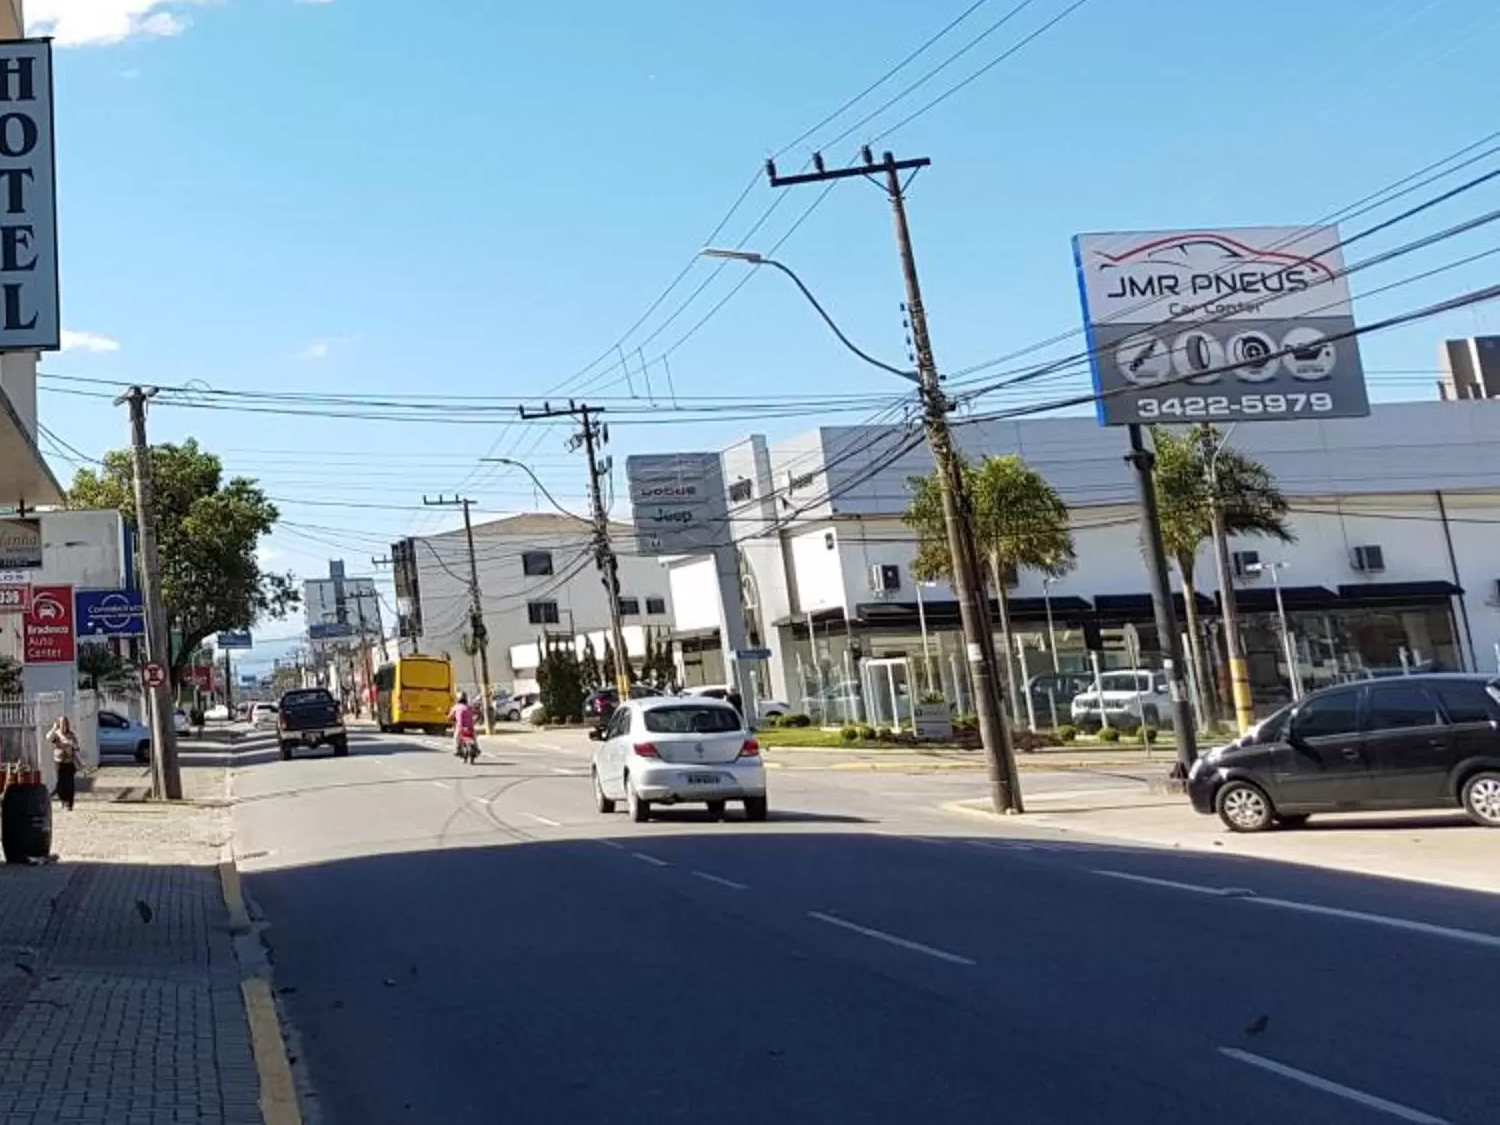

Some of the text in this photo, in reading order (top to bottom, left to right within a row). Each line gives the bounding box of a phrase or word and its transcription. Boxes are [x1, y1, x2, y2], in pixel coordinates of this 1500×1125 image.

[1108, 270, 1308, 298] JMR PNEUS
[1169, 299, 1264, 315] Car Center
[1137, 392, 1333, 417] 3422-5979
[653, 508, 693, 523] Jeep
[27, 648, 61, 659] Center
